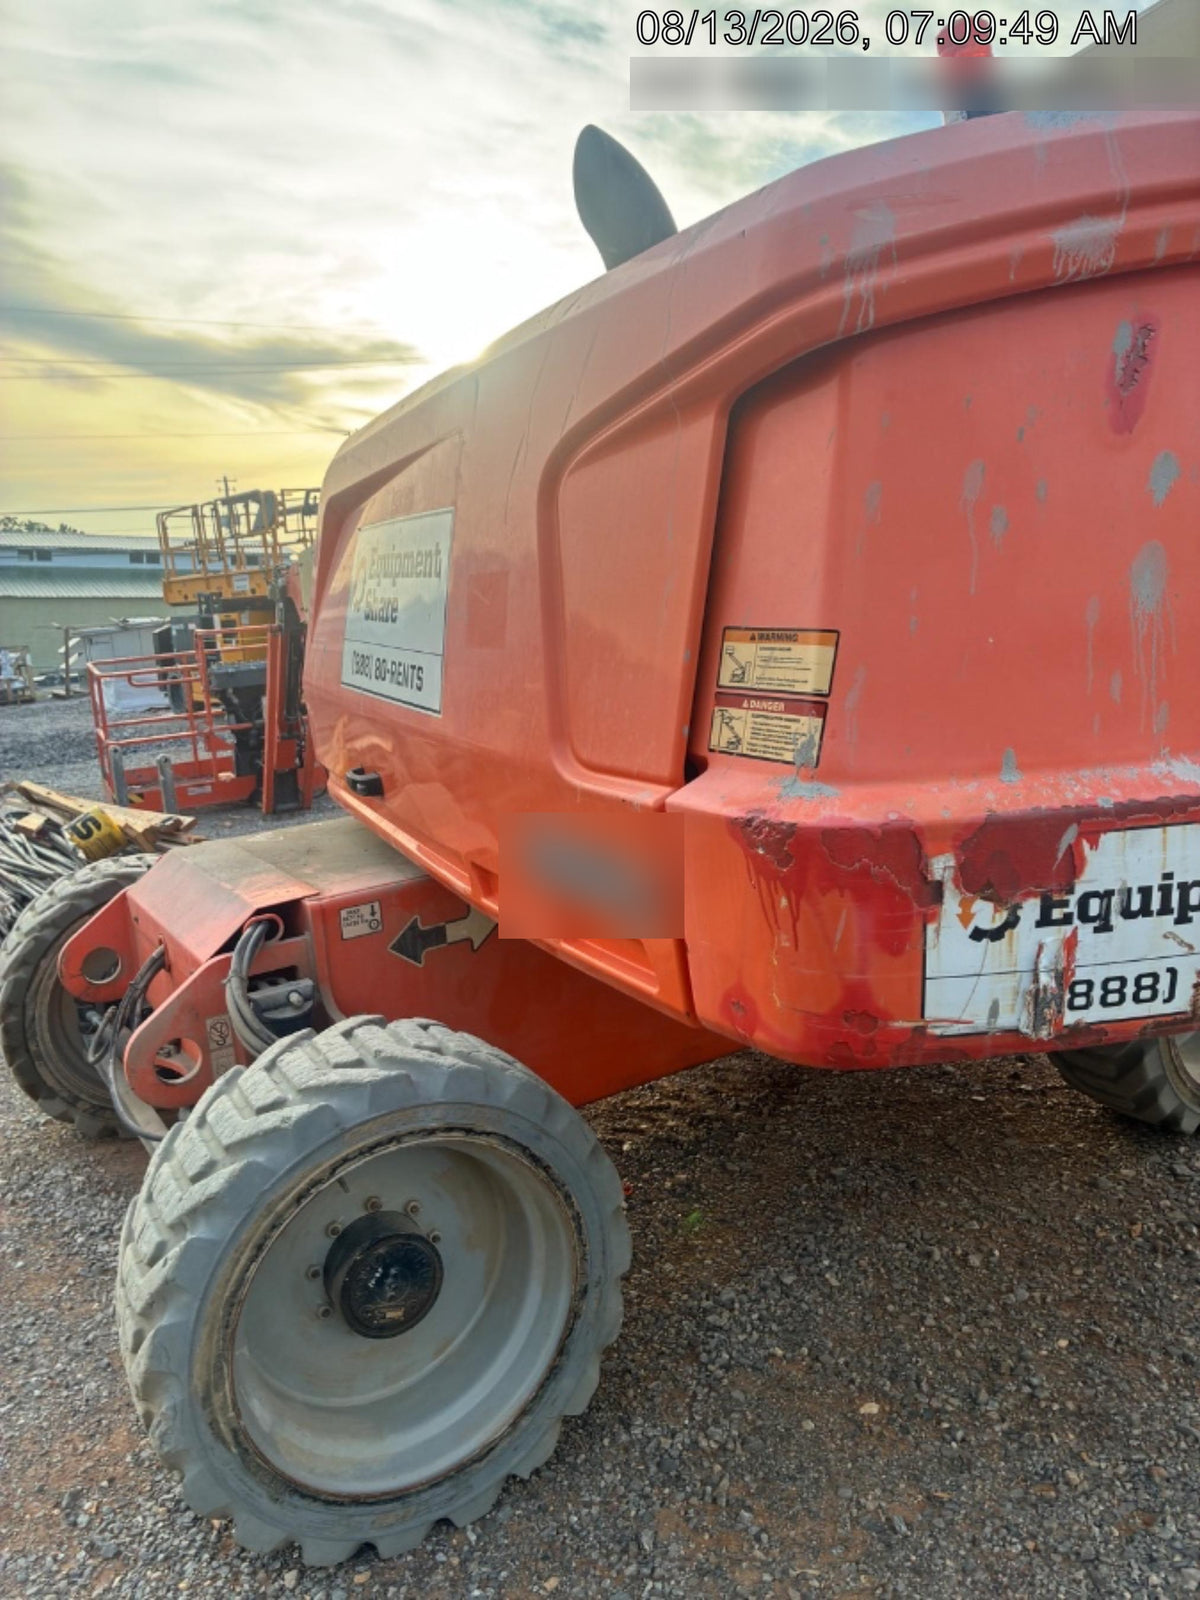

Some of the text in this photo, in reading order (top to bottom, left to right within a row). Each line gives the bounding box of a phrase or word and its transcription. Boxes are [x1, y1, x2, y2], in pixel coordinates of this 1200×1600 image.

[368, 541, 442, 588] Equipment
[757, 631, 799, 643] WARNING
[750, 699, 785, 712] DANGER
[1066, 966, 1178, 1011] 888)
